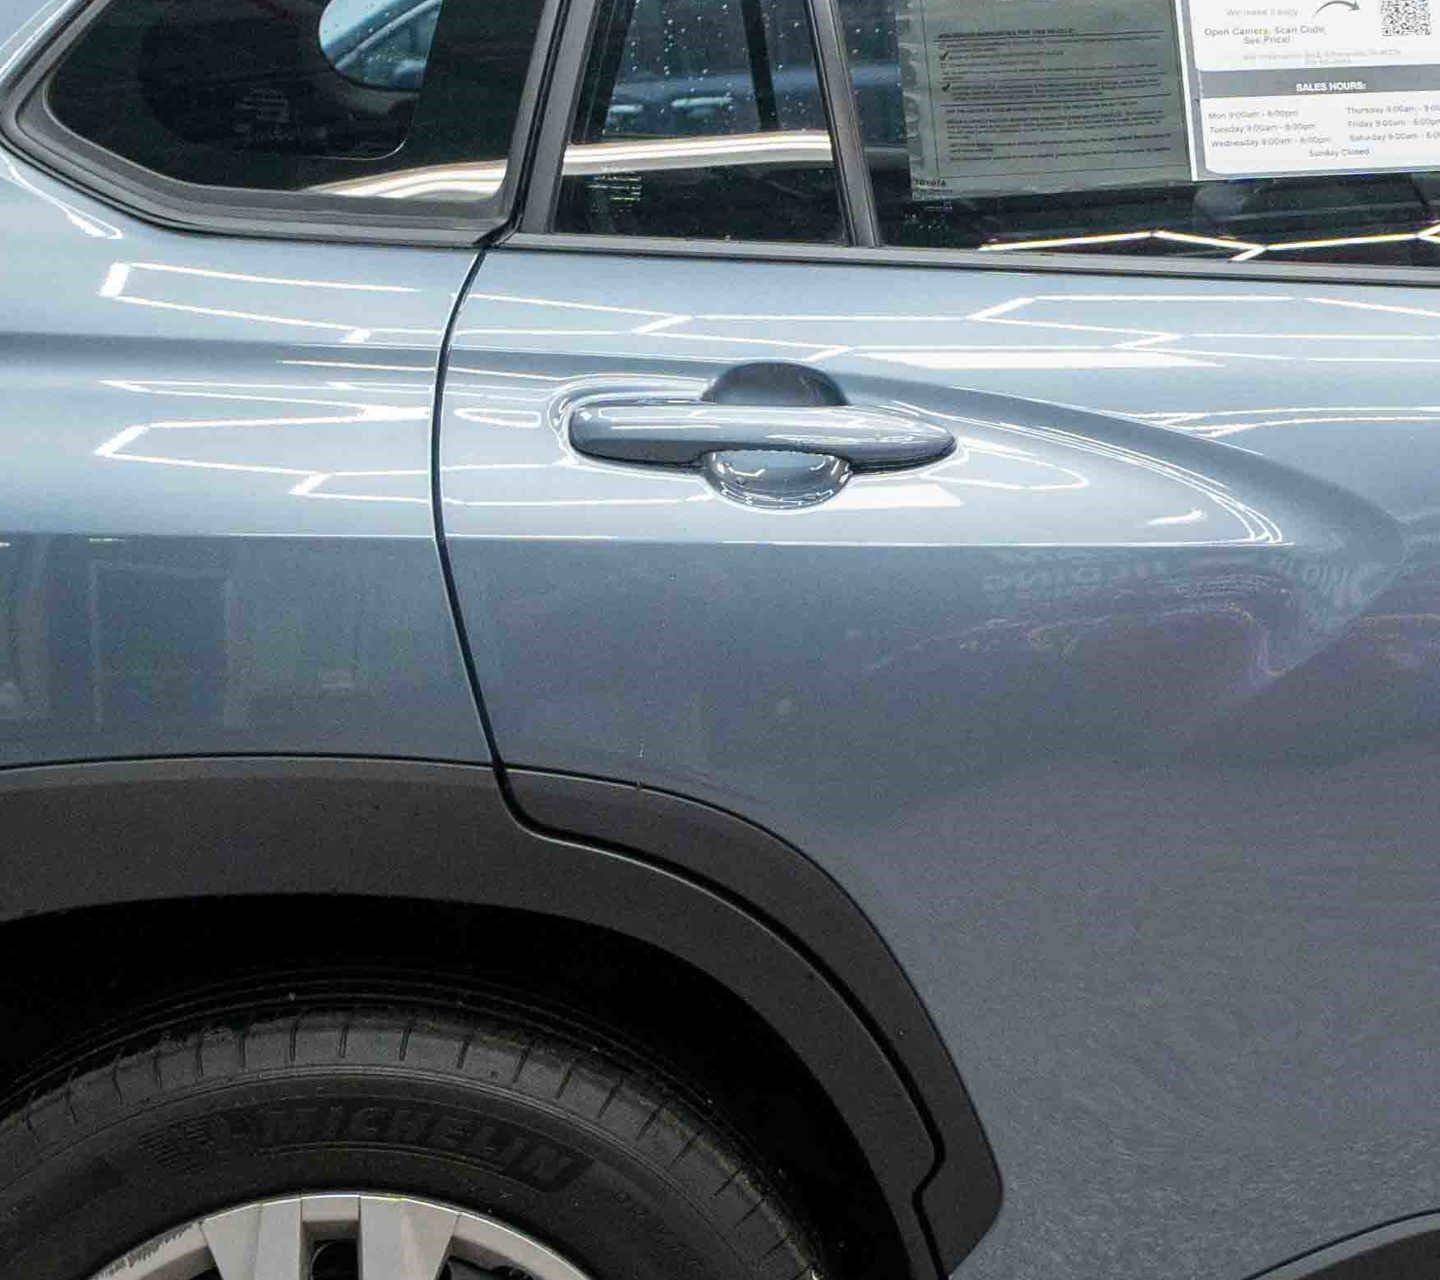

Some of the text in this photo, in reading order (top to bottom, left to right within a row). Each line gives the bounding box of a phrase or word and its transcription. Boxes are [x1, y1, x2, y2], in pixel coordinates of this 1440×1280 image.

[1204, 26, 1230, 38] Open
[1274, 24, 1298, 35] Scan
[1243, 35, 1262, 45] See
[1296, 81, 1367, 93] SALES HOURS:
[1208, 111, 1227, 120] Mon
[1345, 105, 1385, 116] Thursday
[1209, 125, 1244, 136] Tuesday
[1347, 120, 1373, 131] Friday
[1211, 138, 1259, 149] Wednesday
[1349, 133, 1387, 145] Saturday
[1309, 147, 1371, 159] Sunday Closed
[258, 1105, 576, 1184] MICHELIN
